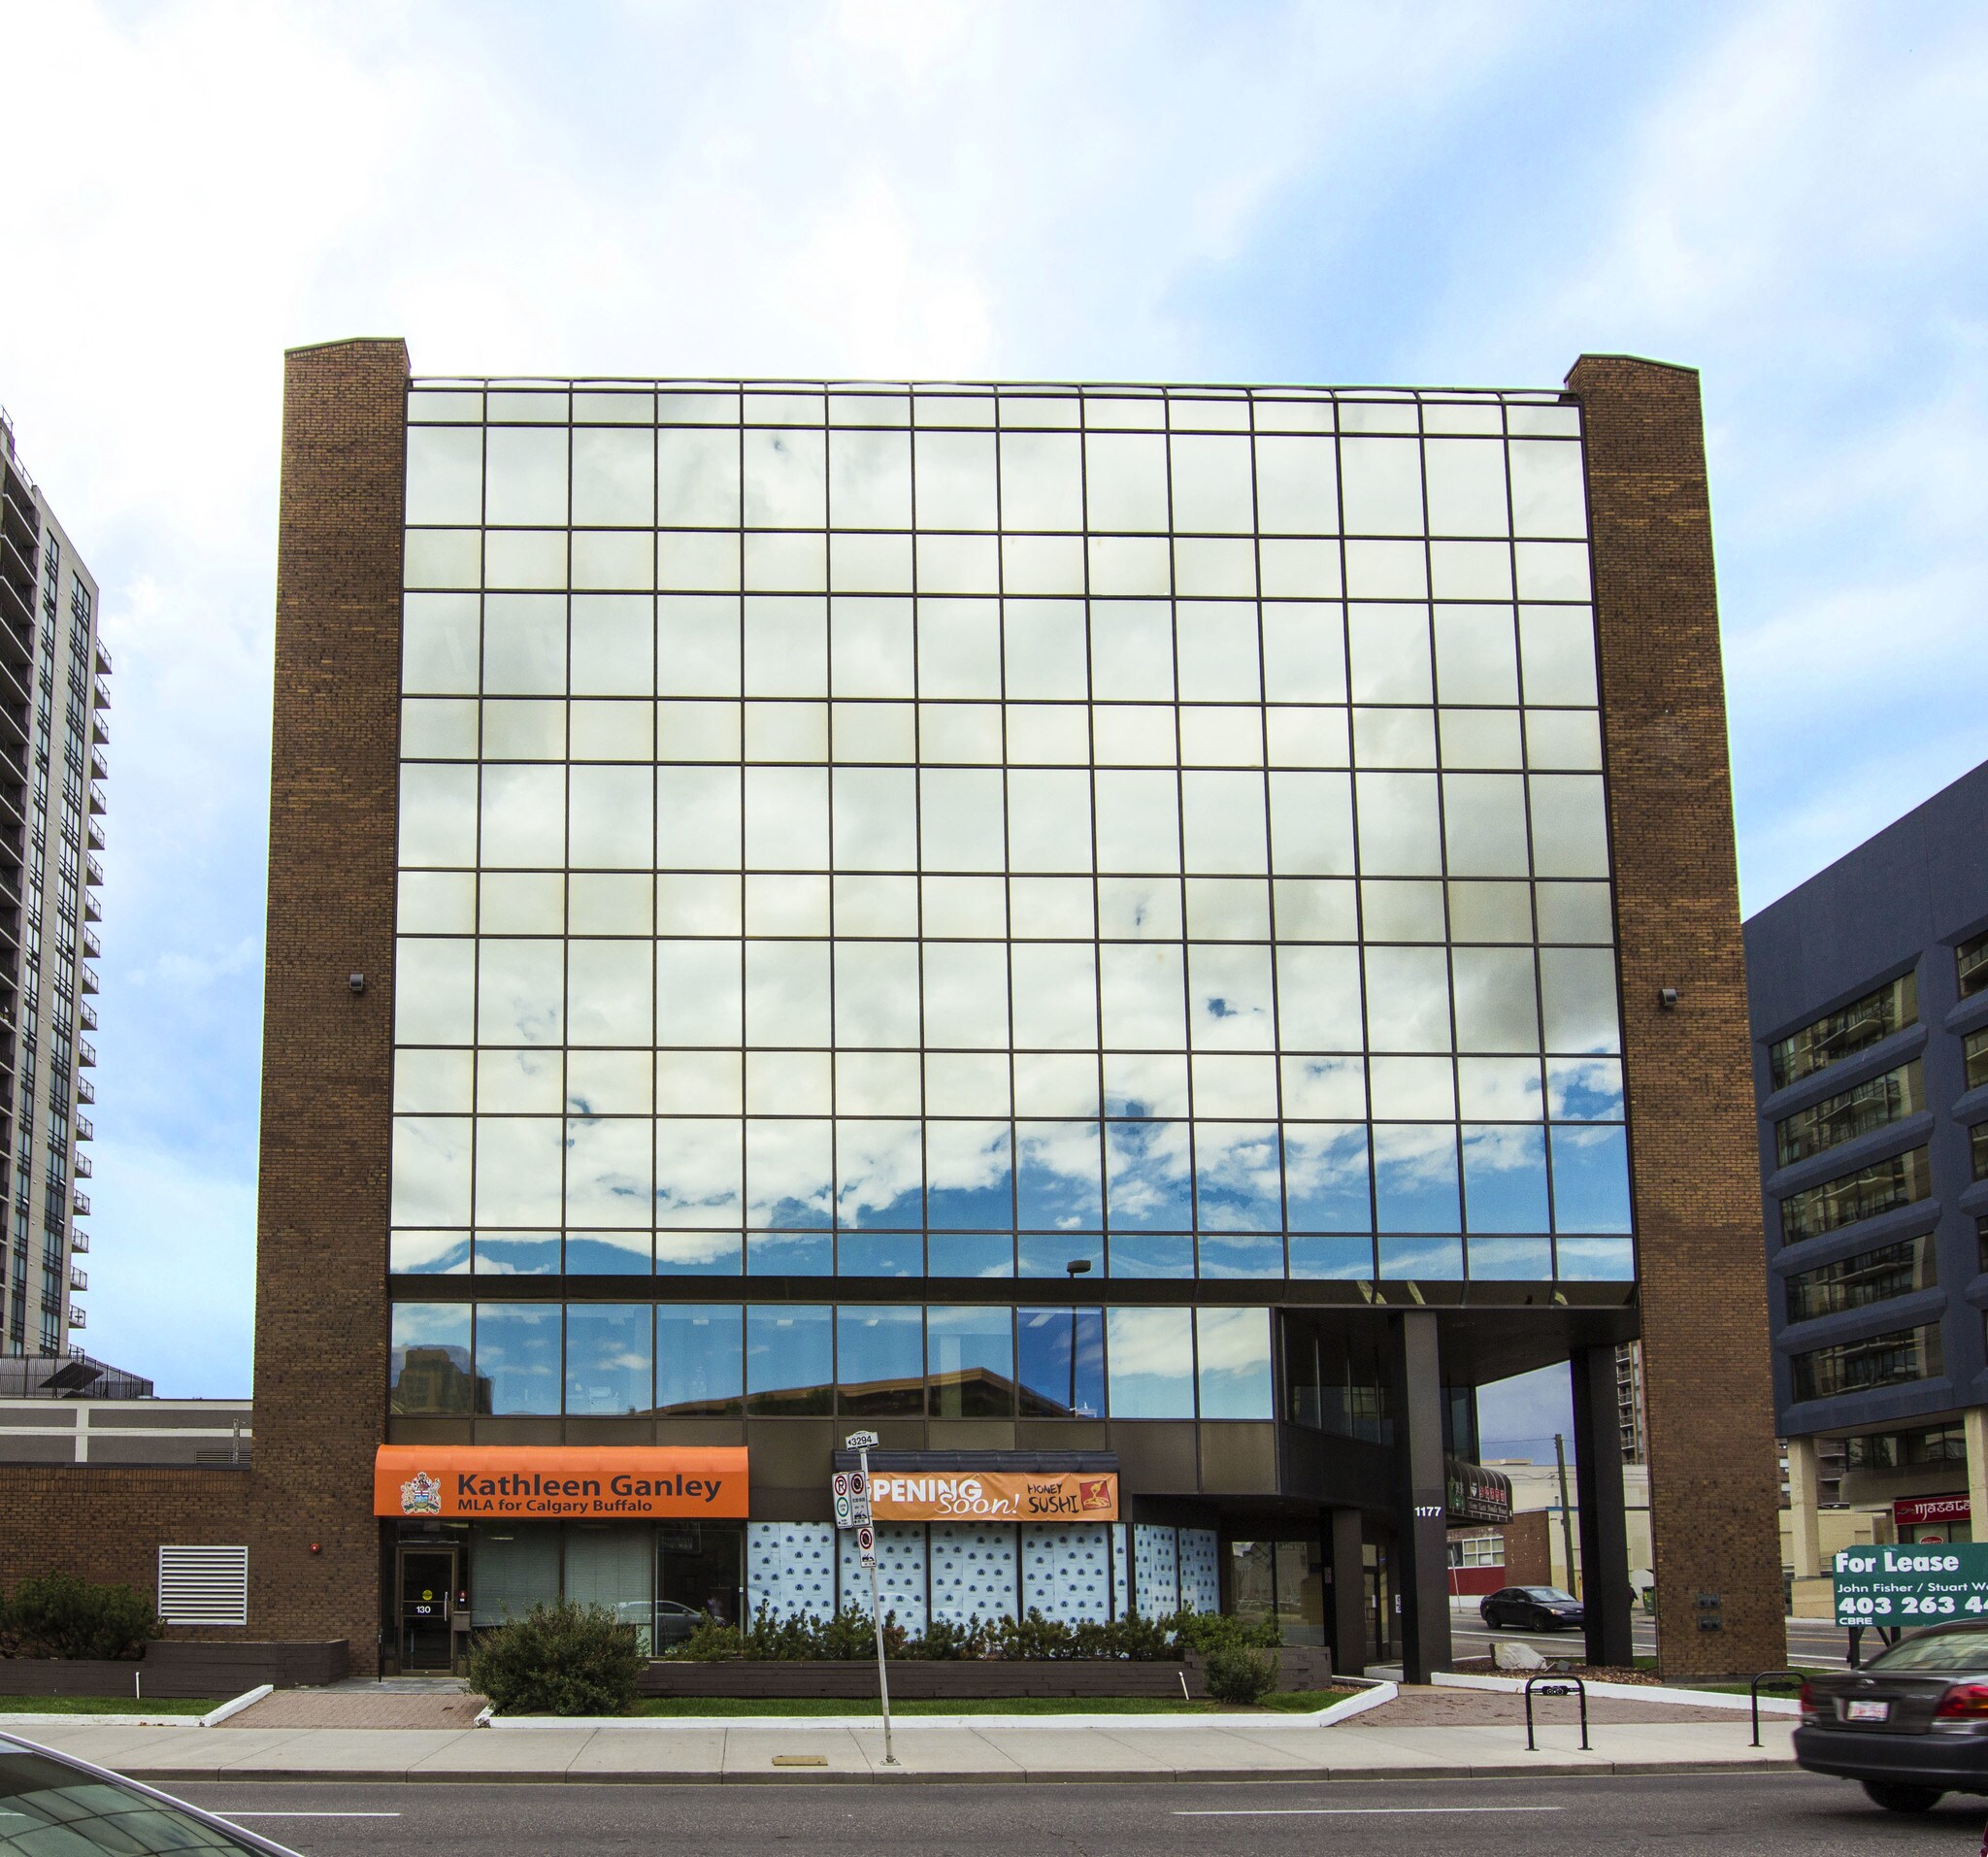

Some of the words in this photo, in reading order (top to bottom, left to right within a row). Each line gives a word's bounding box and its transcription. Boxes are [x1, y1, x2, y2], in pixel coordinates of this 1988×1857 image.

[851, 1436, 872, 1445] 3294
[458, 1474, 600, 1496] Kathleen
[611, 1474, 721, 1503] Ganley
[867, 1478, 982, 1502] PENING
[1027, 1483, 1062, 1494] HONEY
[457, 1499, 494, 1510] MLA
[498, 1499, 522, 1510] for
[526, 1499, 588, 1514] Calgary
[593, 1499, 652, 1511] Buffalo
[934, 1493, 1020, 1514] Soon!
[1028, 1495, 1079, 1513] SUSHI
[1414, 1507, 1441, 1516] 1177
[1836, 1552, 1876, 1573] For
[1884, 1551, 1959, 1572] Lease
[1838, 1583, 1869, 1593] John
[1873, 1583, 1913, 1592] Fisher
[1928, 1582, 1968, 1592] Stuart
[1839, 1597, 1892, 1614] 403
[1901, 1596, 1956, 1614] 263
[1839, 1616, 1872, 1625] CBRE
